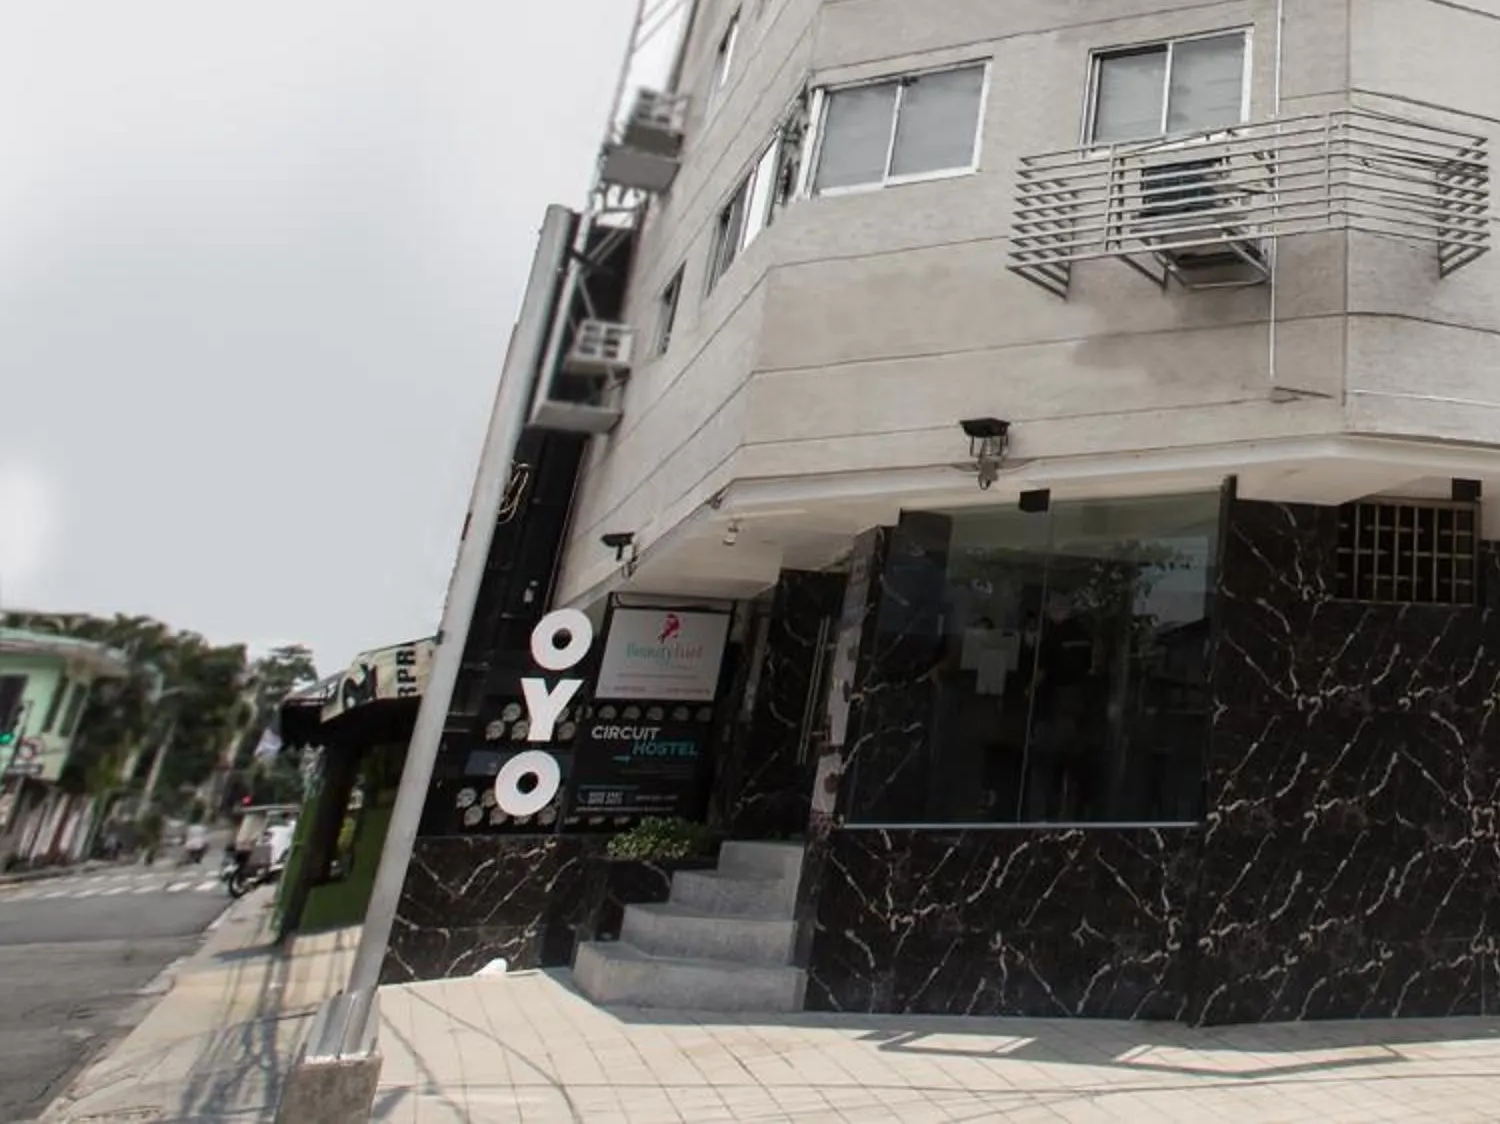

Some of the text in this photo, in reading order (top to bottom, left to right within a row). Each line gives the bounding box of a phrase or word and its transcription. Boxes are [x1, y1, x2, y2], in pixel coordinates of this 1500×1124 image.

[494, 608, 592, 816] OYO
[591, 725, 660, 741] CIRCUIT
[631, 740, 698, 757] HOSTEL
